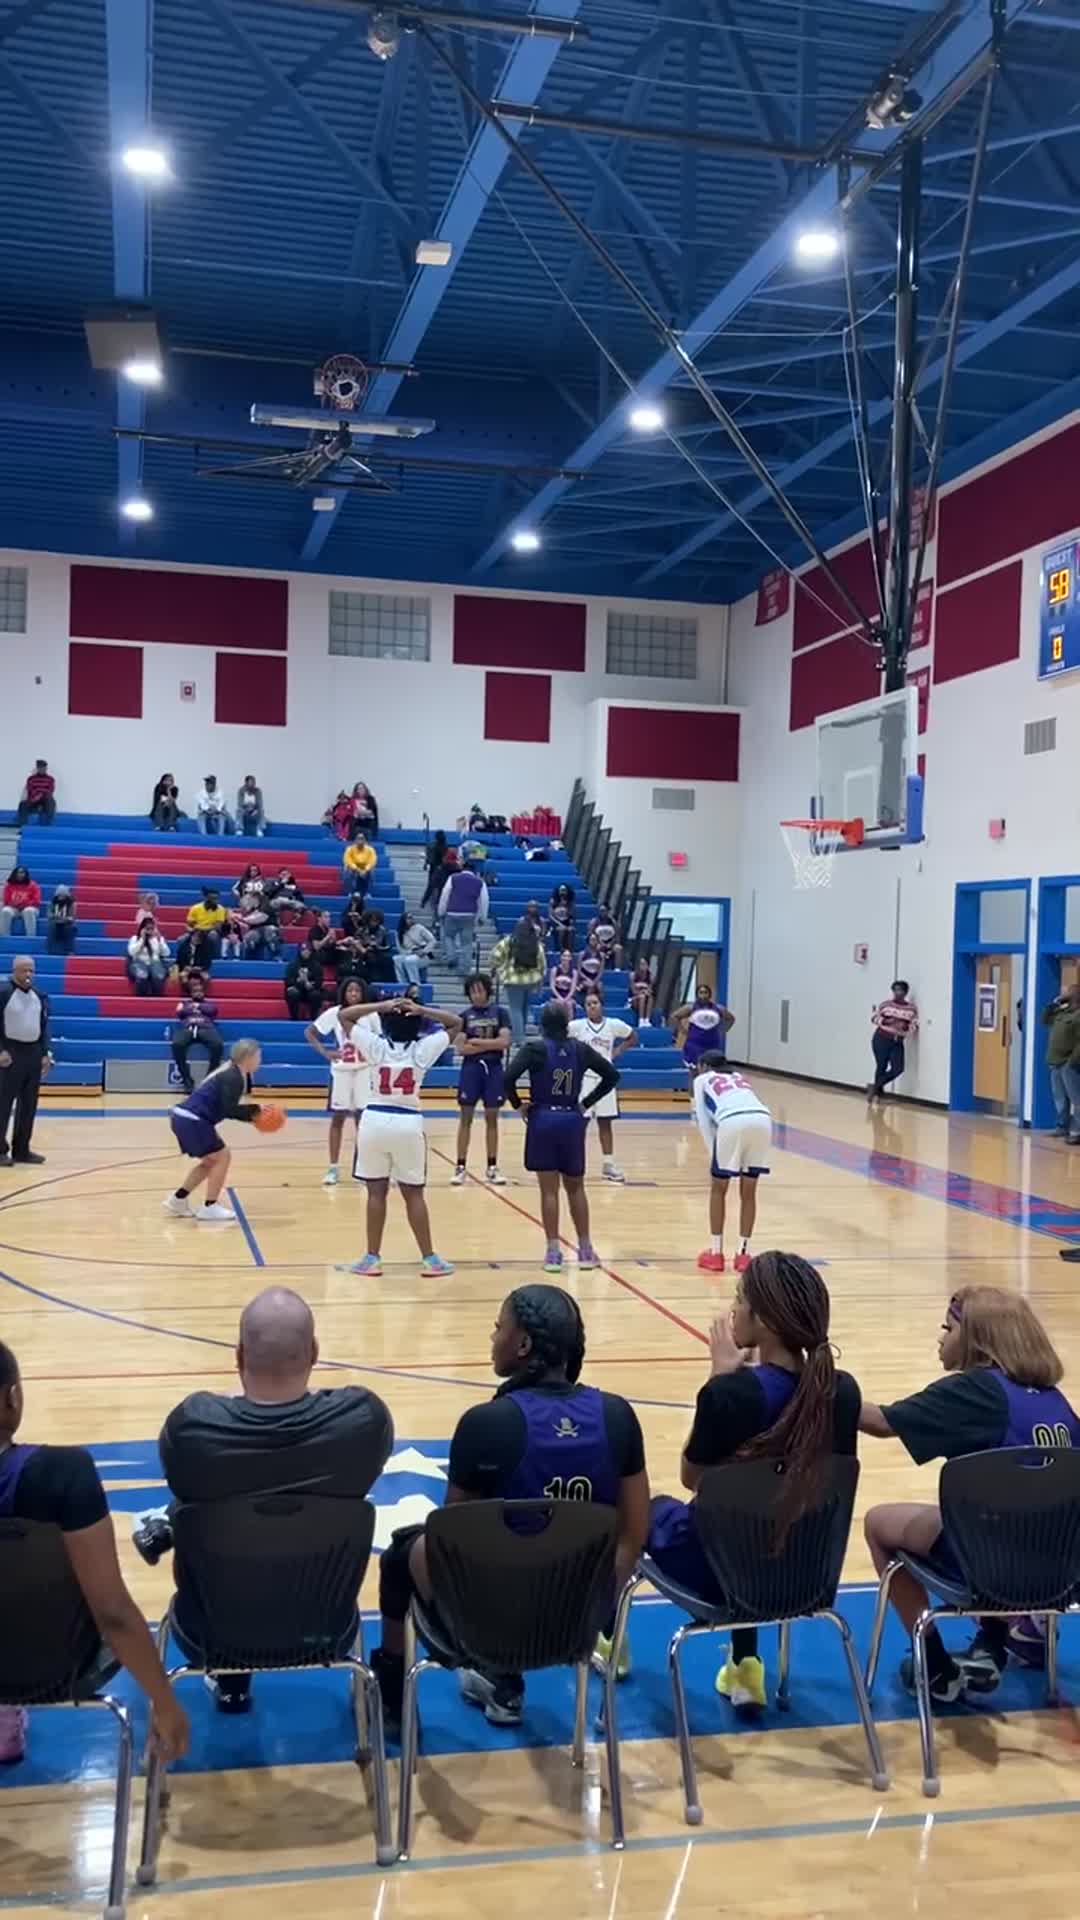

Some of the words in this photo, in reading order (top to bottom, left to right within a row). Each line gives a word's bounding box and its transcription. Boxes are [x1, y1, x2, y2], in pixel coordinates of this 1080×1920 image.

[1048, 569, 1070, 603] 58
[1052, 635, 1063, 661] 0
[379, 1067, 415, 1095] 14
[552, 1068, 572, 1096] 21
